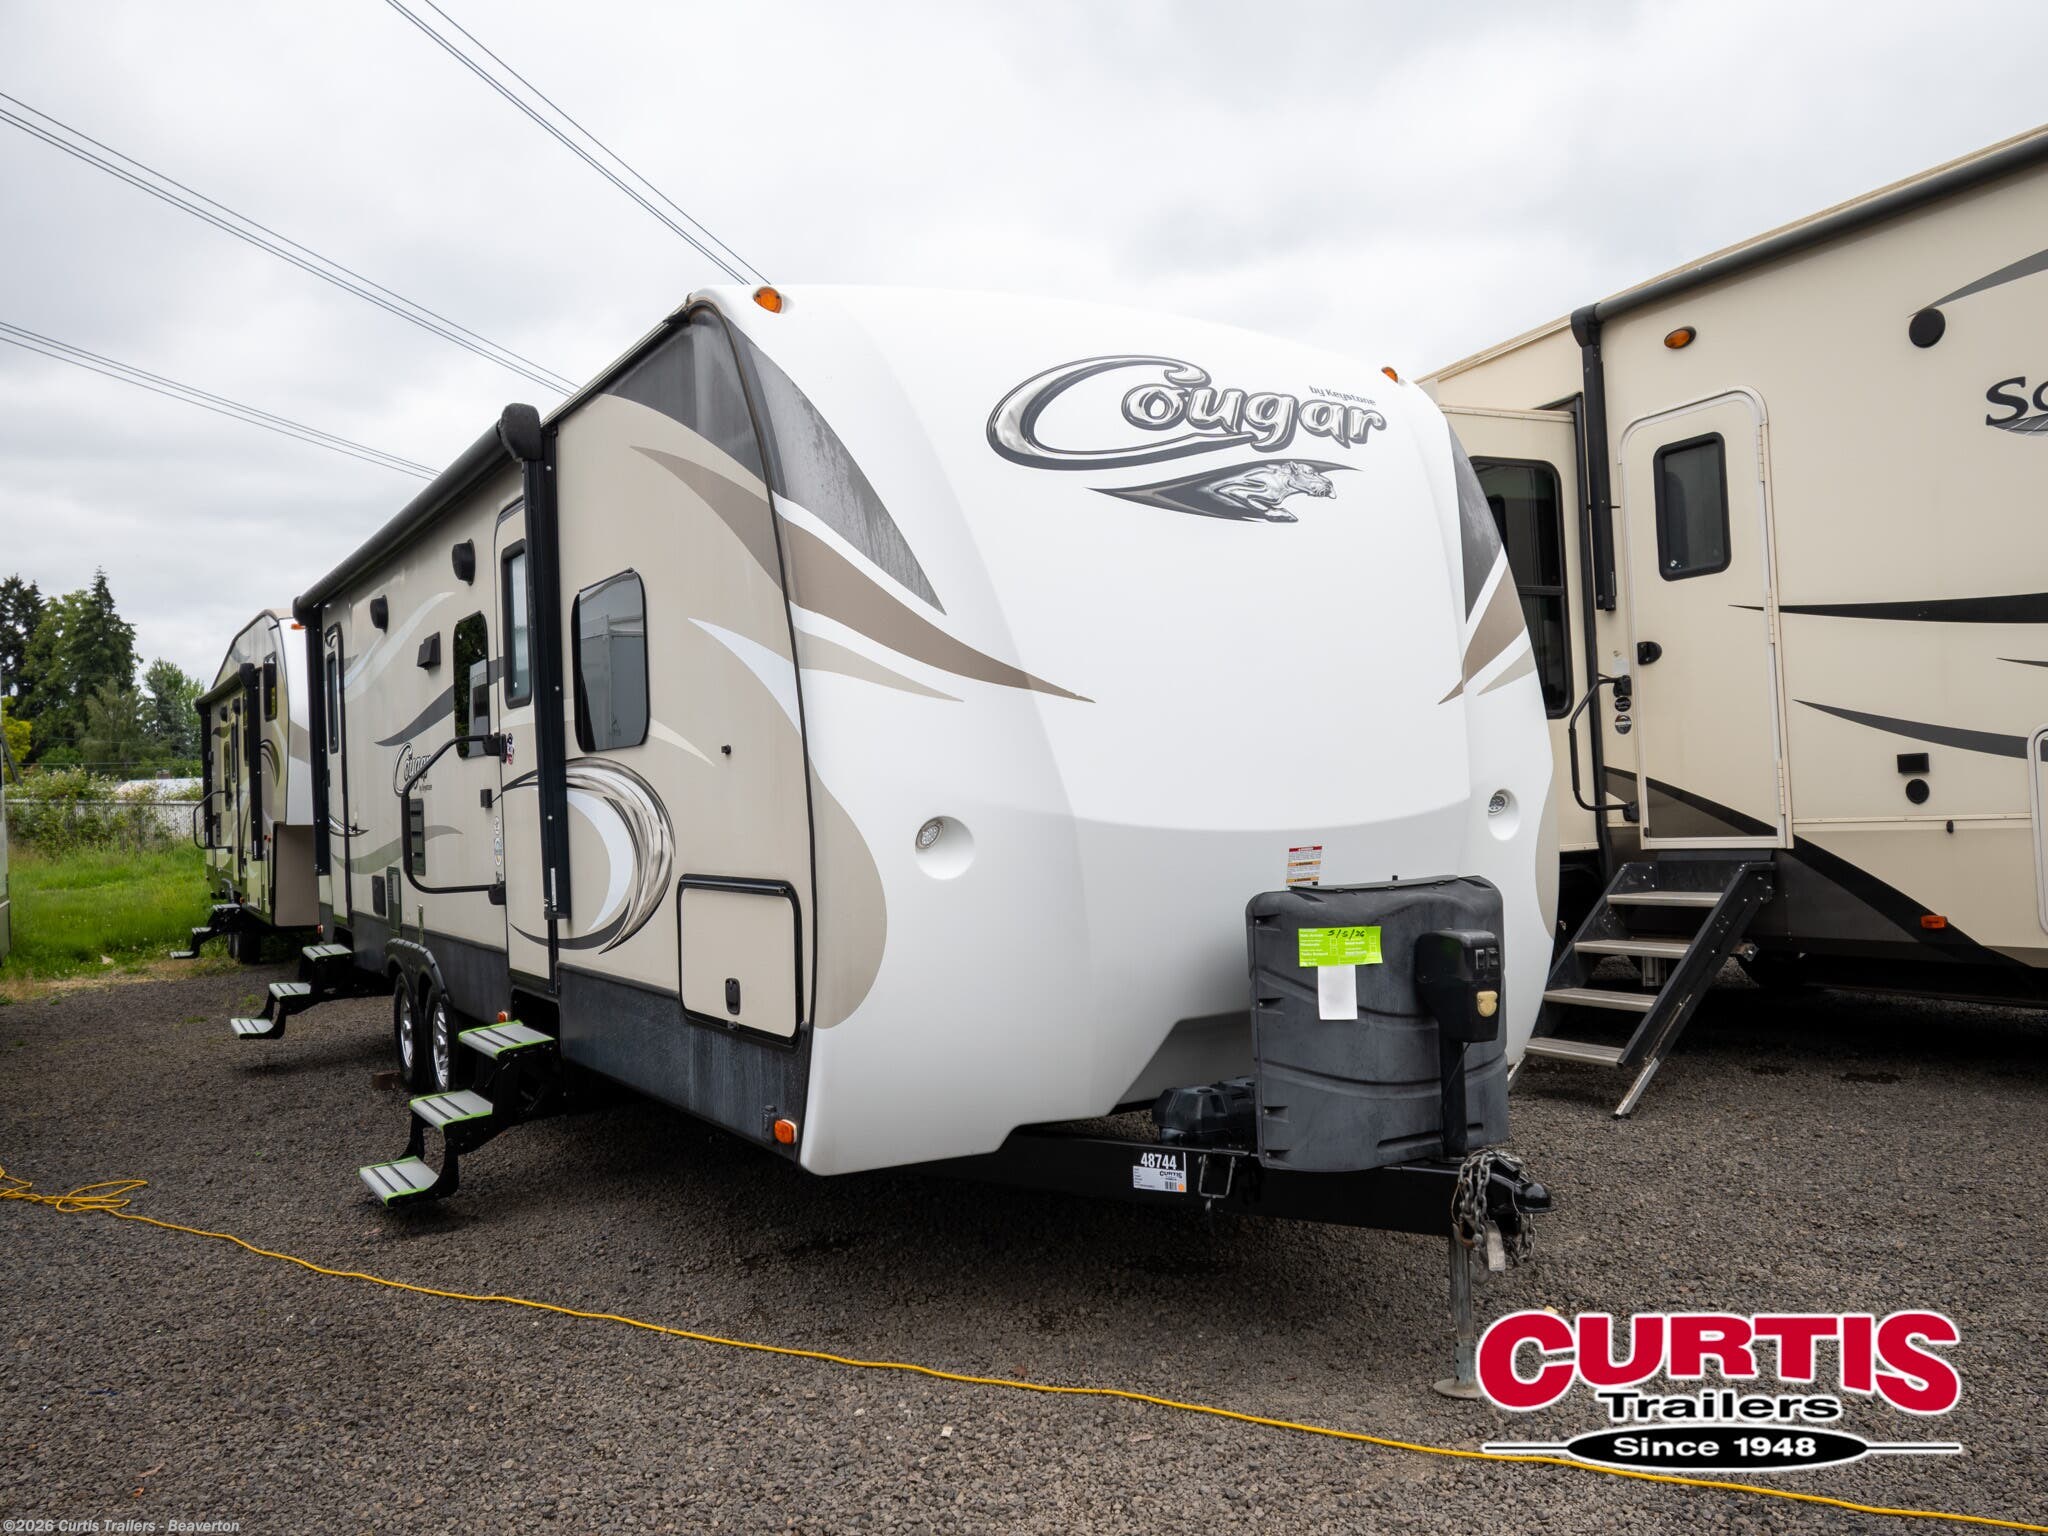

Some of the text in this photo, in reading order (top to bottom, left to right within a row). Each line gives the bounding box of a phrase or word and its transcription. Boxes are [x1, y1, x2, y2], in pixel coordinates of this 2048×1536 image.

[1309, 385, 1376, 405] by Keystone
[986, 354, 1387, 471] Cougar
[1140, 1152, 1177, 1169] 48744
